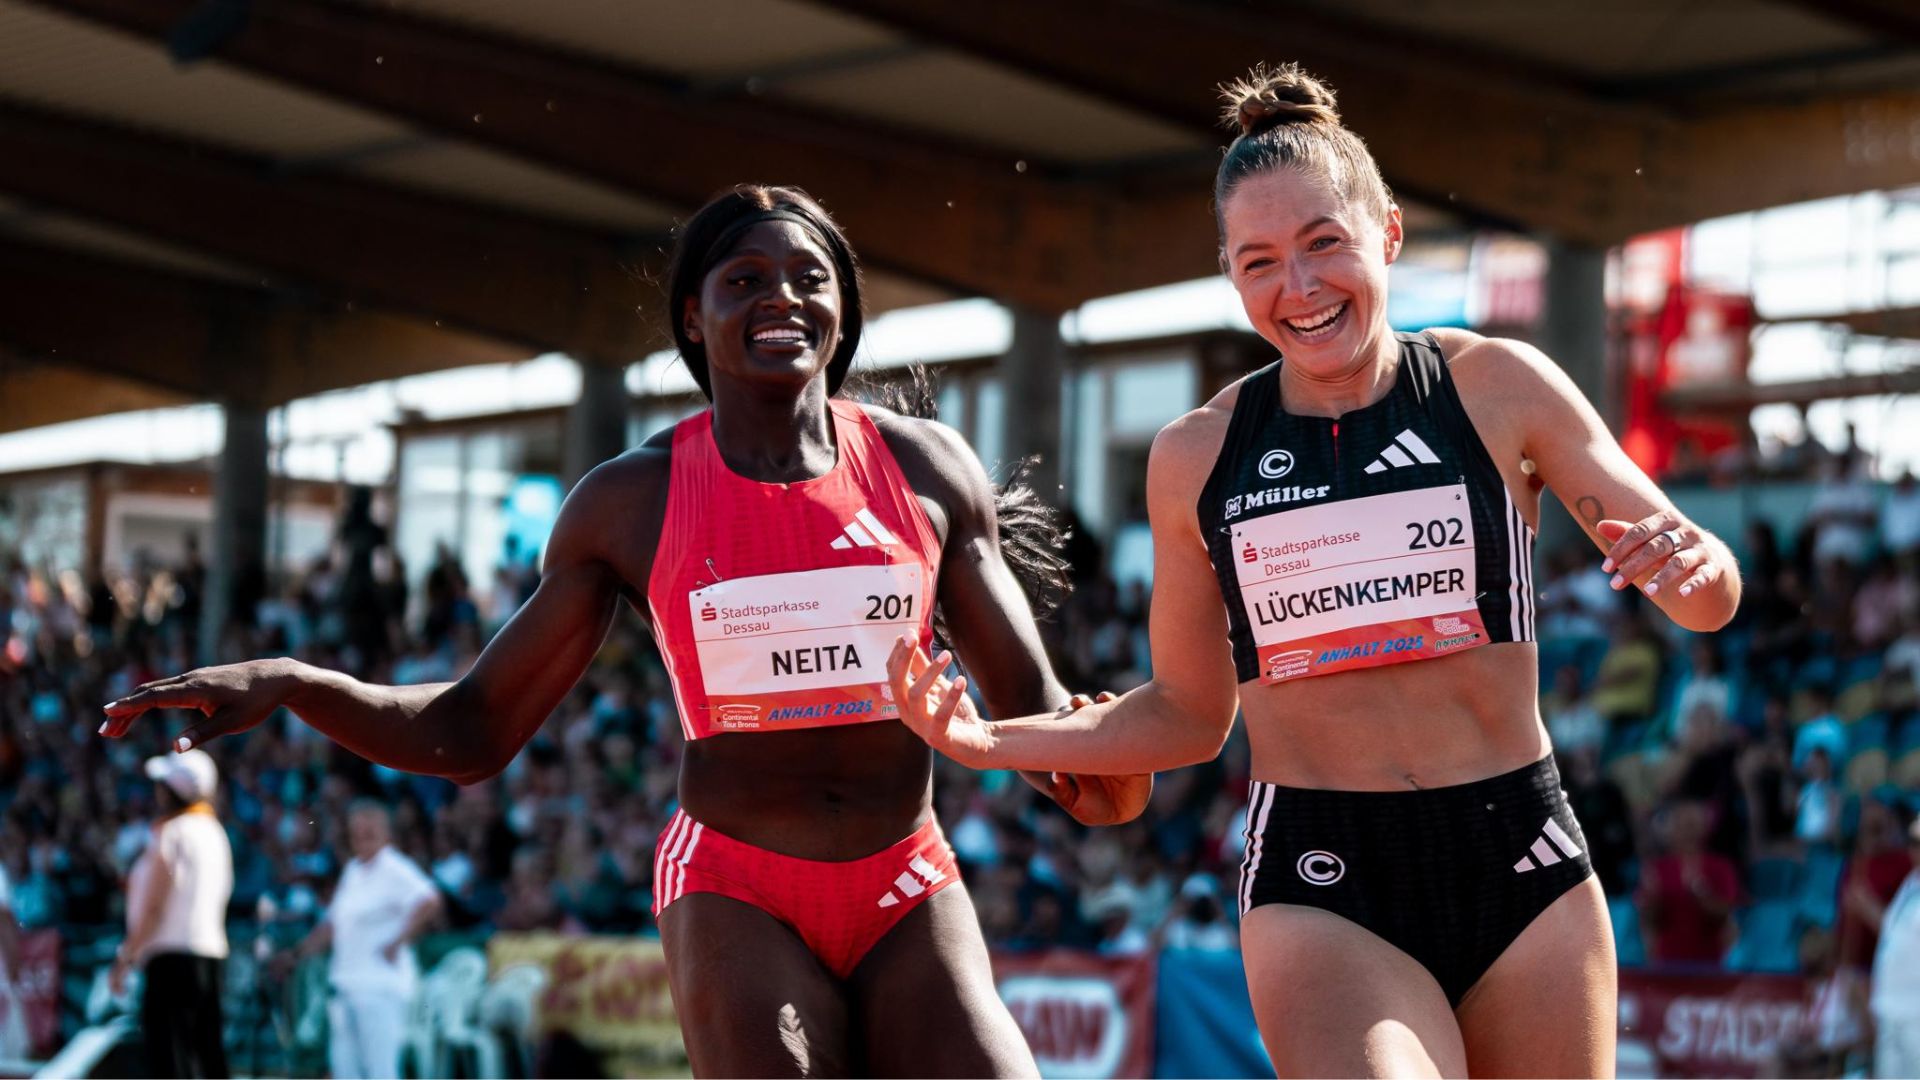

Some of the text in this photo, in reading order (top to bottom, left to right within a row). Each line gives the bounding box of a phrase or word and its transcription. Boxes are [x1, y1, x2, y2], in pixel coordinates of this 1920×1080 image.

[1244, 485, 1331, 510] Müller
[1261, 532, 1361, 560] Stadtsparkasse
[1406, 517, 1465, 550] 202
[1264, 558, 1310, 576] Dessau
[865, 594, 914, 620] 201
[1254, 568, 1465, 626] LÜCKENKEMPER
[721, 601, 820, 619] Stadtsparkasse
[723, 621, 770, 635] Dessau
[771, 644, 862, 676] NEITA
[1316, 635, 1424, 665] ANHALT 2025
[1271, 659, 1310, 672] Continental
[767, 704, 830, 721] ANHALT
[828, 700, 873, 716] 2025
